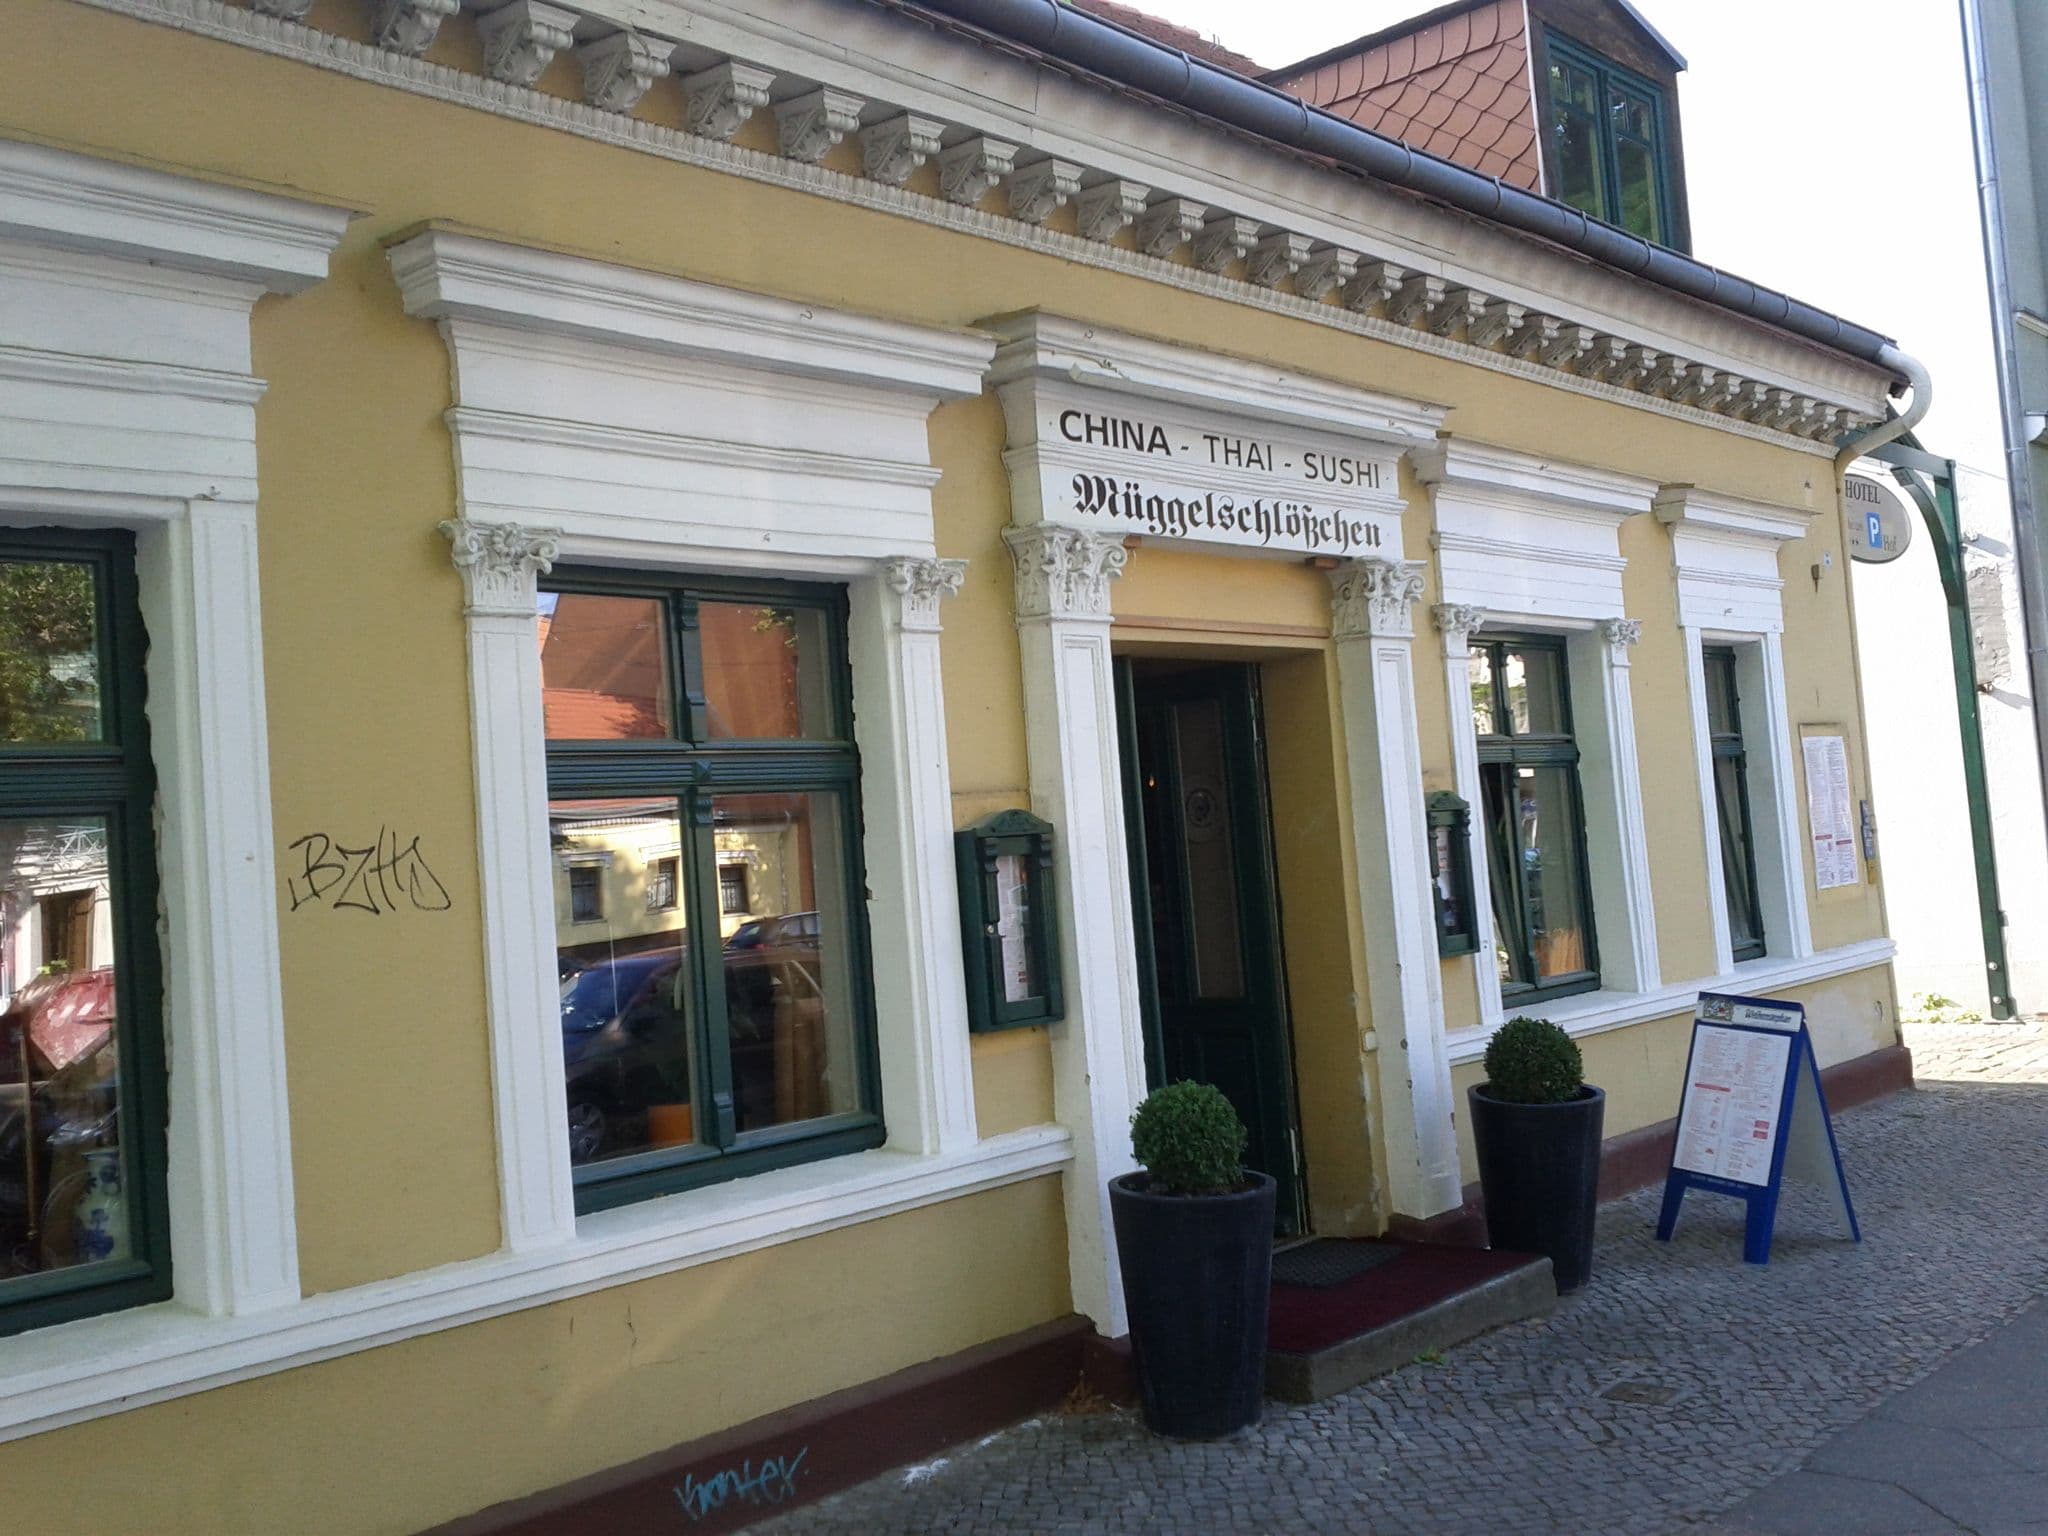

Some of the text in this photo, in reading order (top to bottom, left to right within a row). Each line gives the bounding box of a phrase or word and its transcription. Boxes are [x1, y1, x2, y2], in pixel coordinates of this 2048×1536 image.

[1059, 409, 1171, 456] CHINA
[1203, 434, 1272, 472] THAI
[1304, 452, 1380, 489] SUSHI
[1072, 473, 1382, 553] Müggelschlößchen
[1845, 479, 1880, 504] HOTEL
[1869, 516, 1880, 543] P
